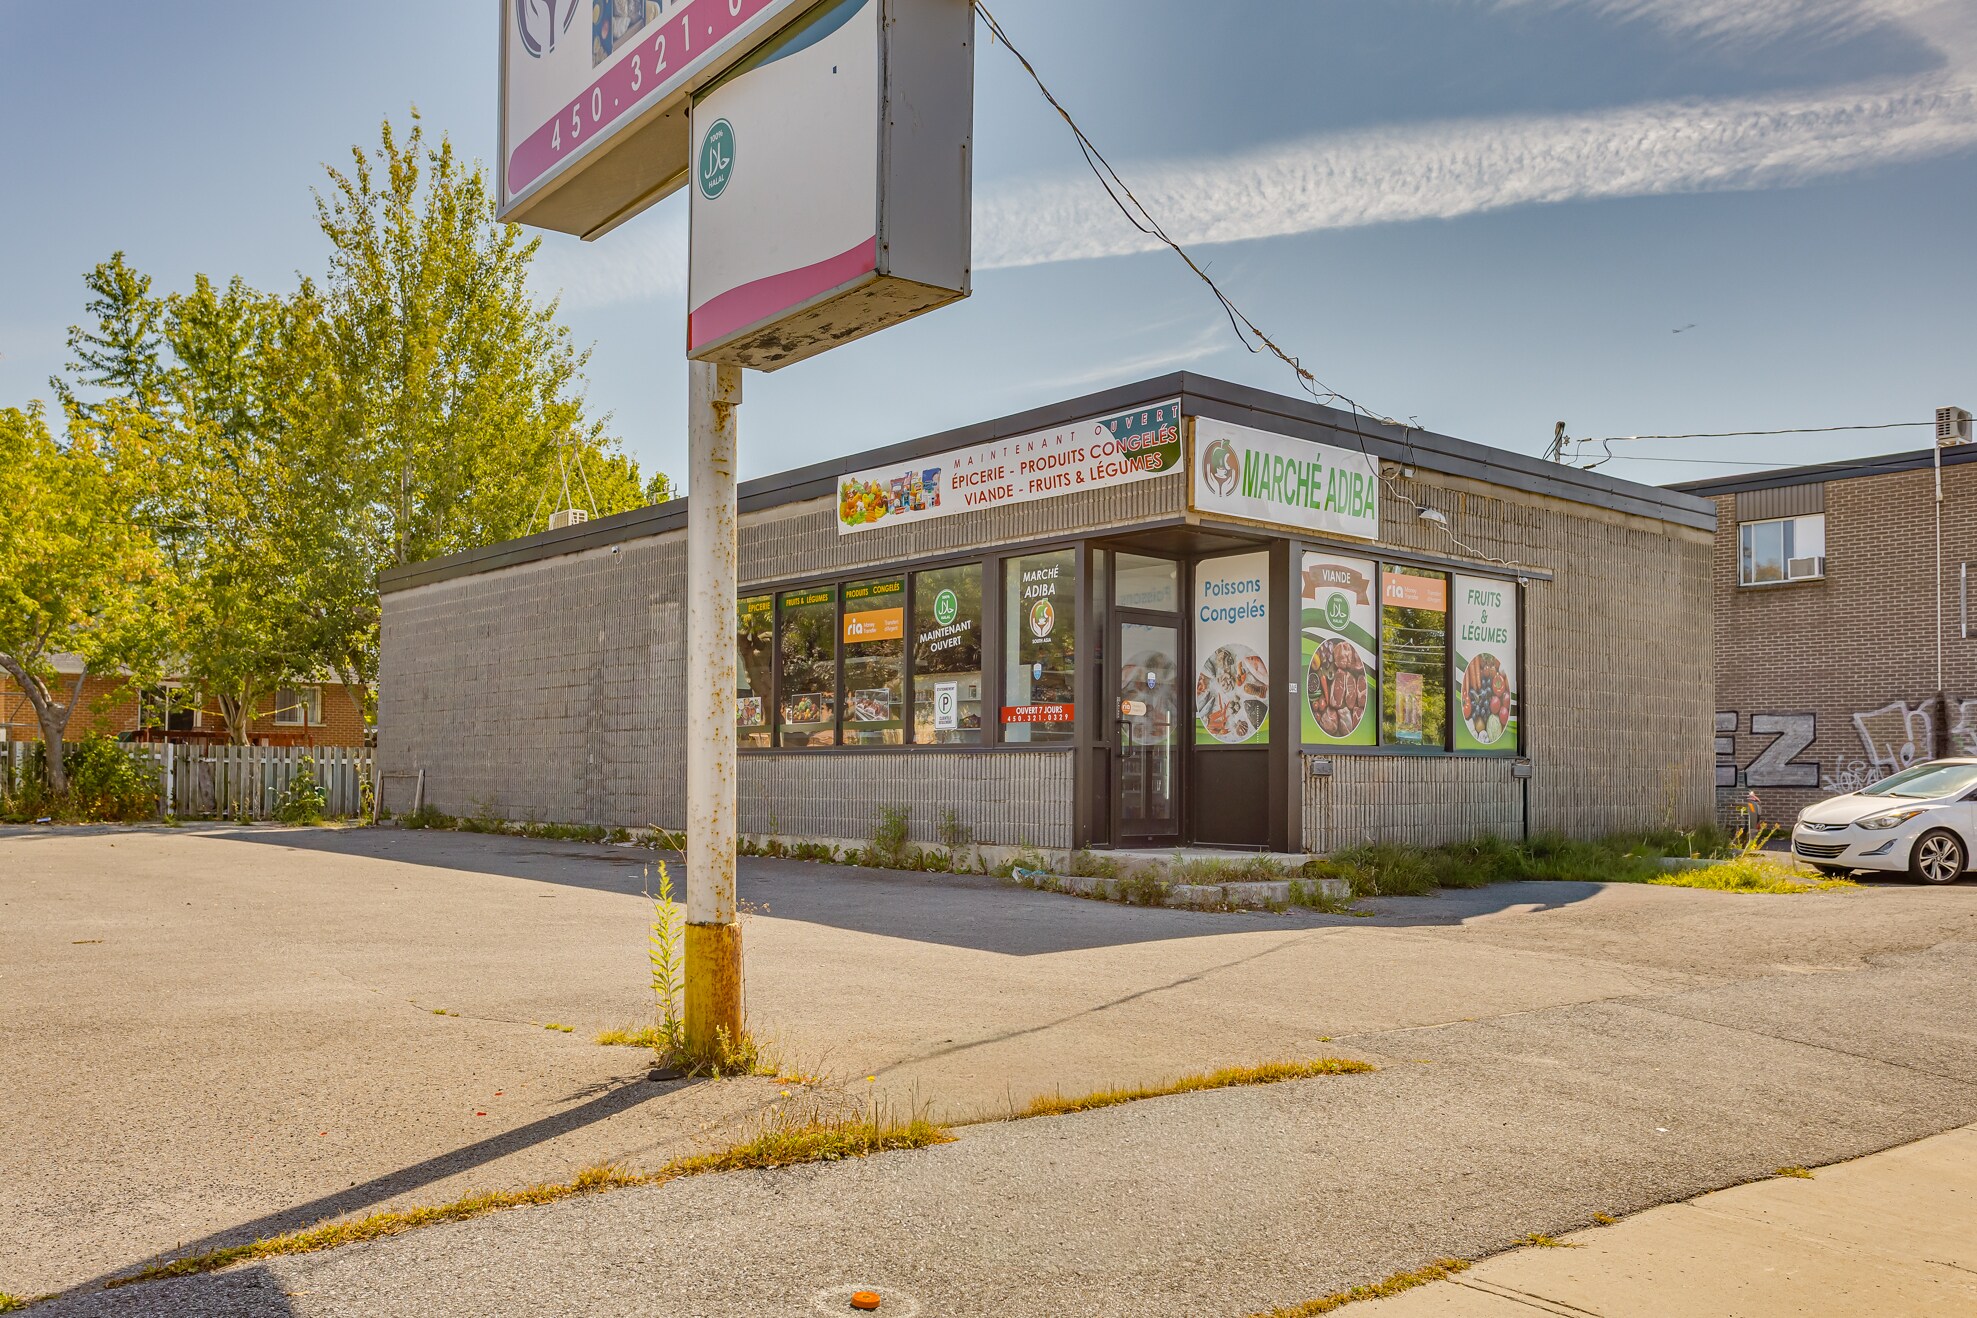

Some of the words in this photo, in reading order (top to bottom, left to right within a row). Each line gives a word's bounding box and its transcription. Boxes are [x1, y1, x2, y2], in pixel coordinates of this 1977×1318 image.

[710, 129, 724, 143] 100%
[704, 142, 730, 179] حلال
[708, 174, 725, 189] HALAL
[953, 431, 1076, 469] MAINTENANT
[1094, 405, 1179, 436] OUVERT
[951, 466, 1005, 490] ÉPICERIE
[1020, 445, 1085, 475] PRODUITS
[1089, 426, 1178, 459] CONGELÉS
[964, 487, 1014, 506] VIANDE
[1029, 474, 1071, 494] FRUITS
[1076, 470, 1085, 484] &
[1090, 452, 1163, 481] LÉGUMES
[1241, 449, 1322, 510] MARCHÉ
[1324, 467, 1375, 520] ADIBA
[1022, 564, 1059, 582] MARCHÉ
[1322, 569, 1351, 584] VIANDE
[846, 588, 869, 599] PRODUITS
[873, 582, 900, 594] CONGELÉS
[1024, 583, 1056, 598] ADIBA
[1204, 579, 1261, 597] Poissons
[1386, 579, 1404, 598] ria
[748, 601, 771, 613] ÉPICERIE
[785, 598, 800, 607] FRUITS
[806, 594, 829, 604] LÉGUMES
[1467, 589, 1502, 608] FRUITS
[1200, 599, 1265, 624] Congelés
[1481, 609, 1488, 624] &
[847, 617, 863, 635] ria
[919, 620, 971, 643] MAINTENANT
[1461, 620, 1508, 644] LÉGUMES
[930, 636, 962, 652] OUVERT
[943, 696, 949, 711] P
[1015, 707, 1038, 715] OUVERT
[1039, 706, 1043, 714] 7
[1044, 705, 1063, 714] JOURS
[1007, 714, 1069, 722] 450.321.0329
